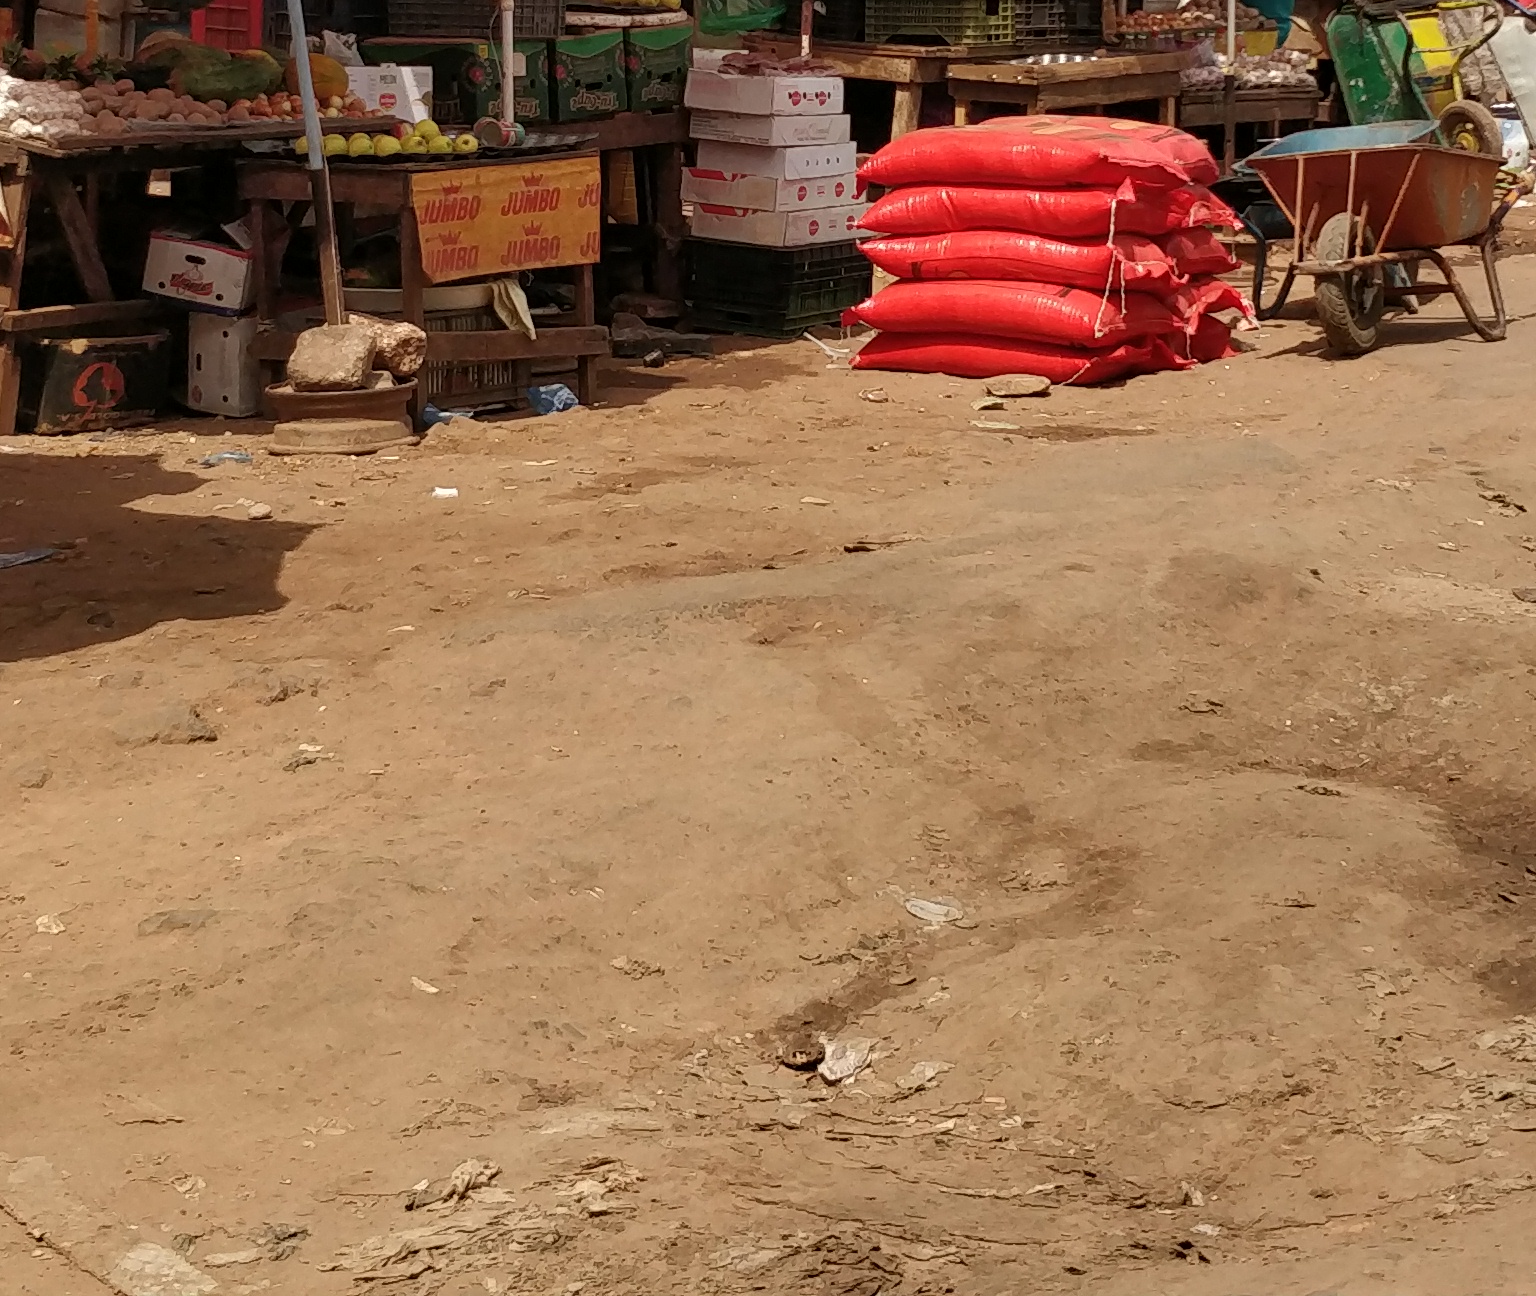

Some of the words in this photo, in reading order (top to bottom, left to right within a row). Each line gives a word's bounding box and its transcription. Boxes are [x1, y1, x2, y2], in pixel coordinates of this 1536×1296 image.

[419, 194, 482, 226] JUMBO
[500, 186, 562, 217] JUMBO
[500, 235, 562, 267] JUMBO
